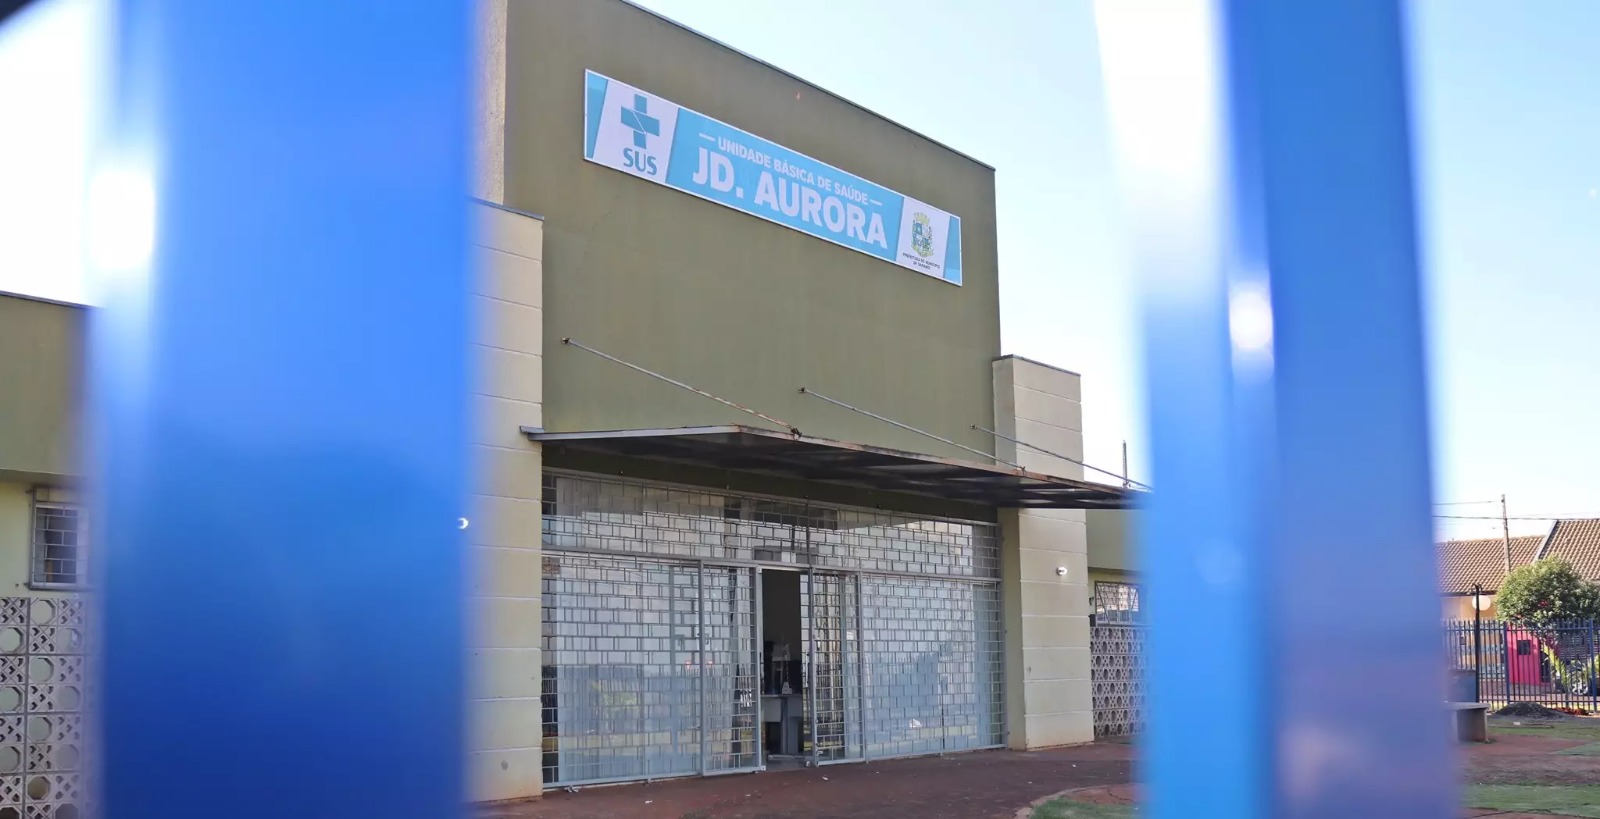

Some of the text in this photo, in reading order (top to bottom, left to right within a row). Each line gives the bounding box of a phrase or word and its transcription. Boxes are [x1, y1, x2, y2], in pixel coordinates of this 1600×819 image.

[623, 147, 657, 176] SUS
[717, 136, 868, 205] UNIDADE BÁSICA DE SAÚDE
[692, 146, 888, 249] JD. AURORA
